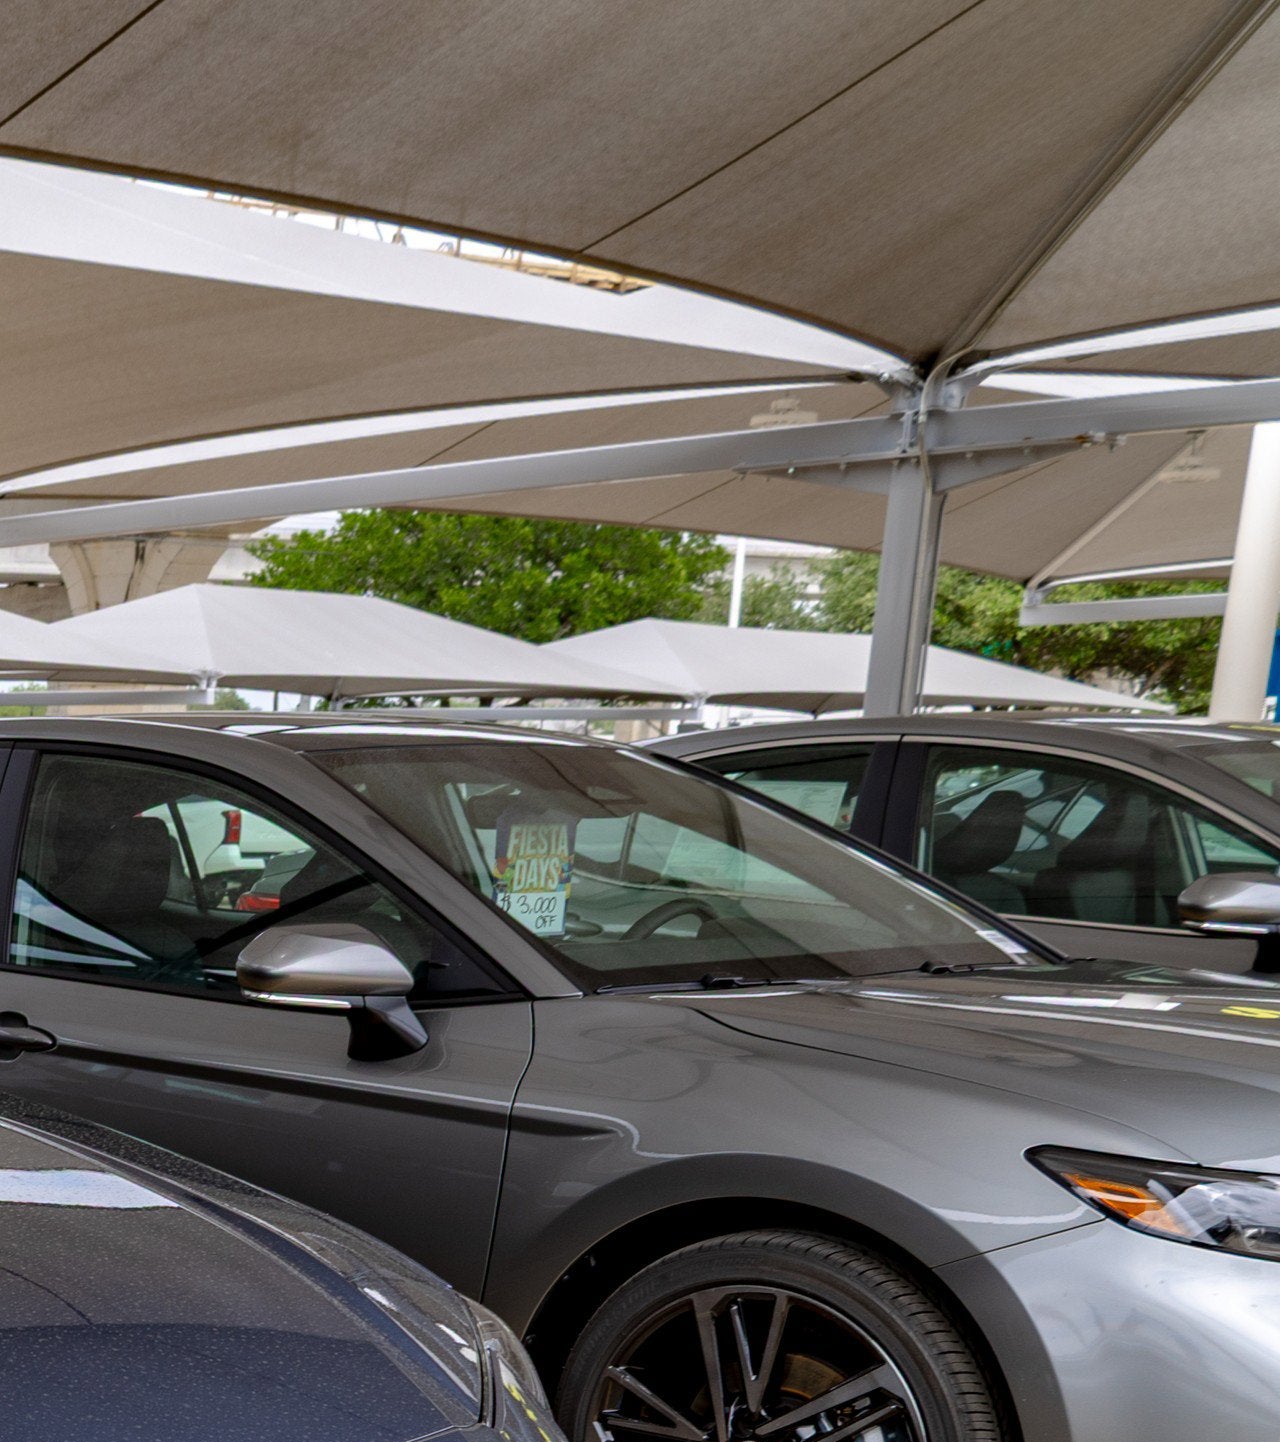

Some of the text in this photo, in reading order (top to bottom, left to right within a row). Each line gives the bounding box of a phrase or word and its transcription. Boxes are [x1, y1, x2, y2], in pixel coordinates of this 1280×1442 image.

[507, 824, 569, 859] FIESTA
[513, 857, 560, 892] DAYS
[535, 915, 558, 929] OFF
